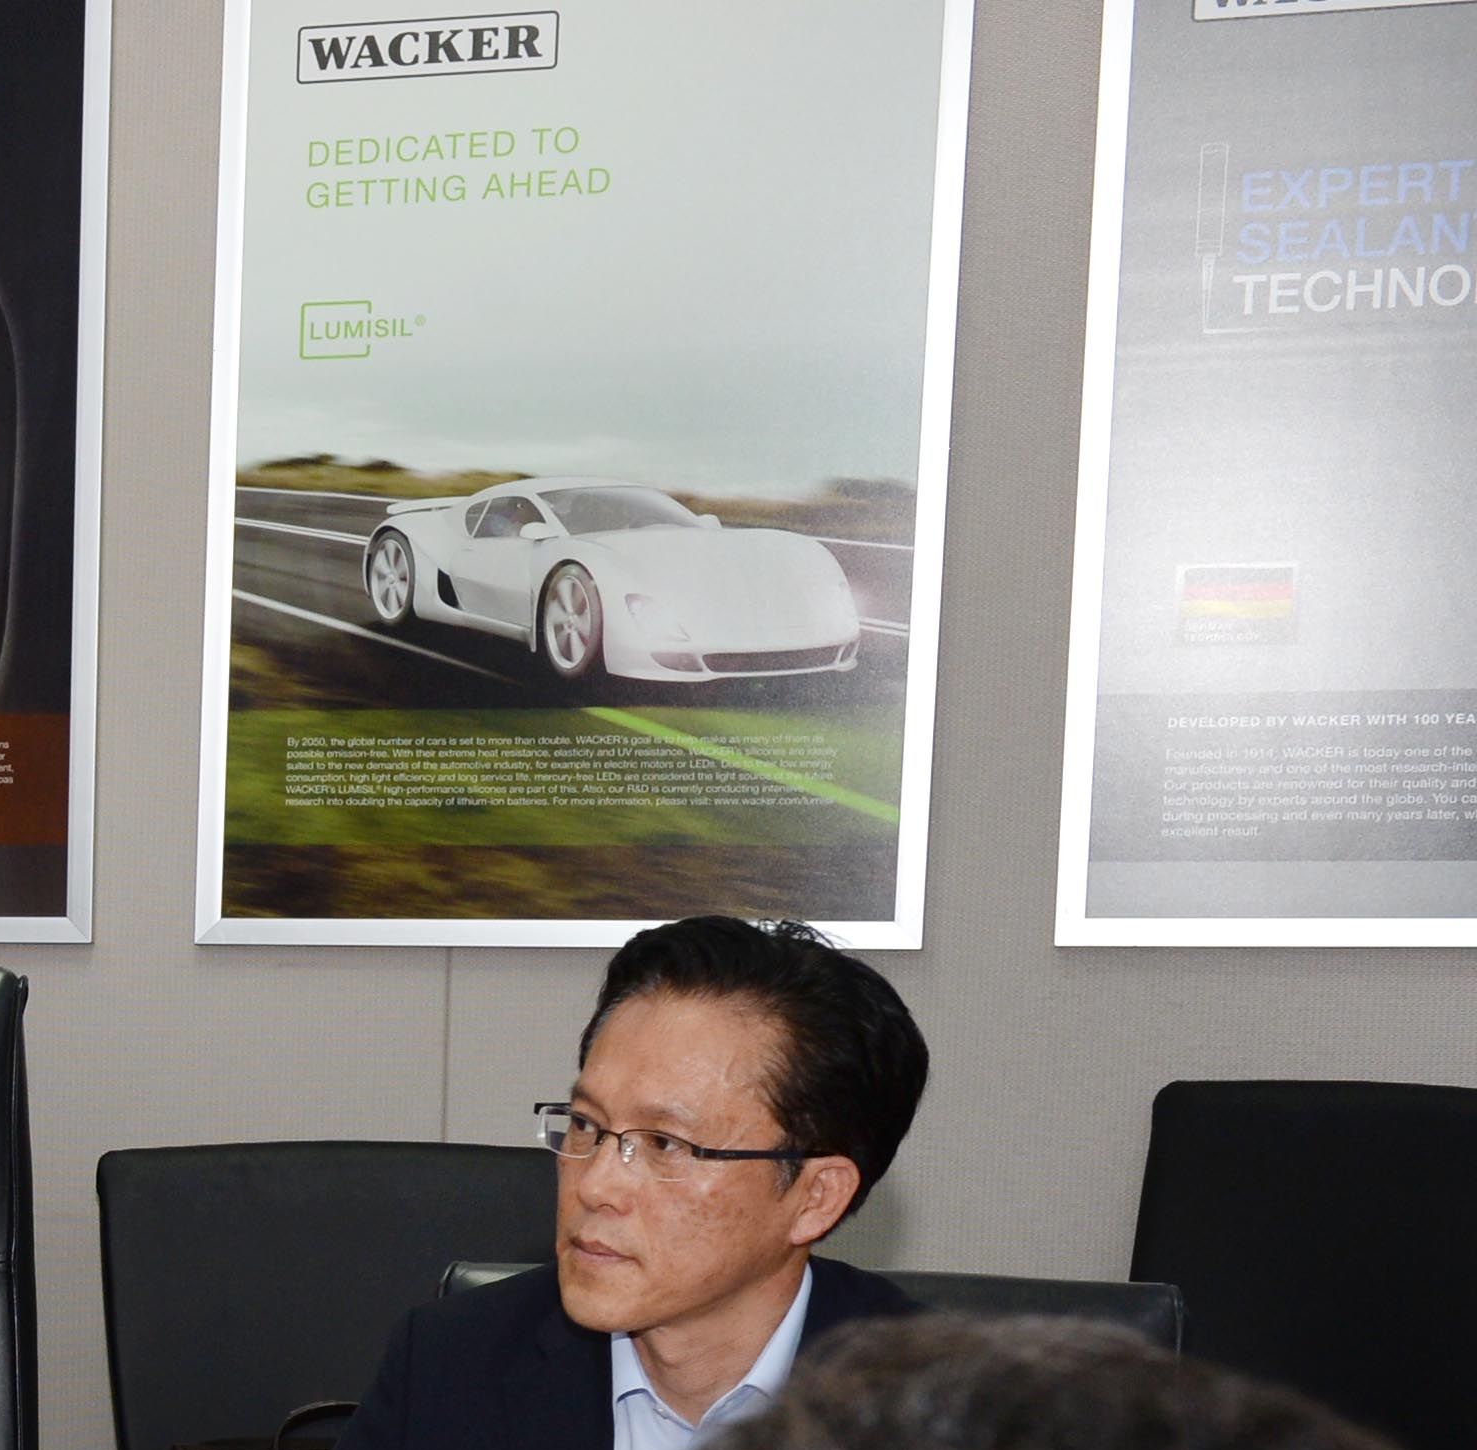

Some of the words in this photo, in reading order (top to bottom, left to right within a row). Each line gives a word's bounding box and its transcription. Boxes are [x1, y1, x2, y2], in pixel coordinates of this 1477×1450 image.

[307, 24, 543, 72] WACKER
[308, 129, 515, 167] DEDICATED
[531, 126, 580, 156] TO
[305, 173, 467, 209] GETTING
[482, 167, 612, 200] AHEAD
[1241, 159, 1475, 213] EXPERT
[1236, 211, 1477, 265] SEALAN
[287, 737, 300, 748] By
[301, 737, 328, 747] 2050,
[329, 736, 345, 746] the
[346, 736, 375, 748] global
[376, 736, 413, 746] number
[414, 736, 424, 746] of
[426, 738, 447, 746] cars
[448, 736, 457, 745] is
[458, 736, 474, 745] set
[475, 736, 486, 745] to
[514, 735, 535, 745] than
[537, 735, 573, 745] double.
[630, 735, 651, 746] goal
[1167, 715, 1261, 729] DEVELOPED
[1266, 715, 1287, 728] BY
[1292, 714, 1361, 727] WACKER
[1366, 714, 1407, 726] WITH
[1413, 713, 1439, 725] 100
[286, 761, 314, 770] suited
[315, 760, 325, 770] to
[327, 760, 342, 770] the
[344, 762, 364, 770] new
[365, 760, 409, 770] demands
[410, 760, 421, 770] of
[422, 760, 438, 770] the
[534, 760, 548, 769] for
[549, 760, 591, 771] example
[592, 760, 602, 769] in
[603, 760, 638, 769] electric
[639, 759, 674, 769] motors
[675, 761, 687, 769] or
